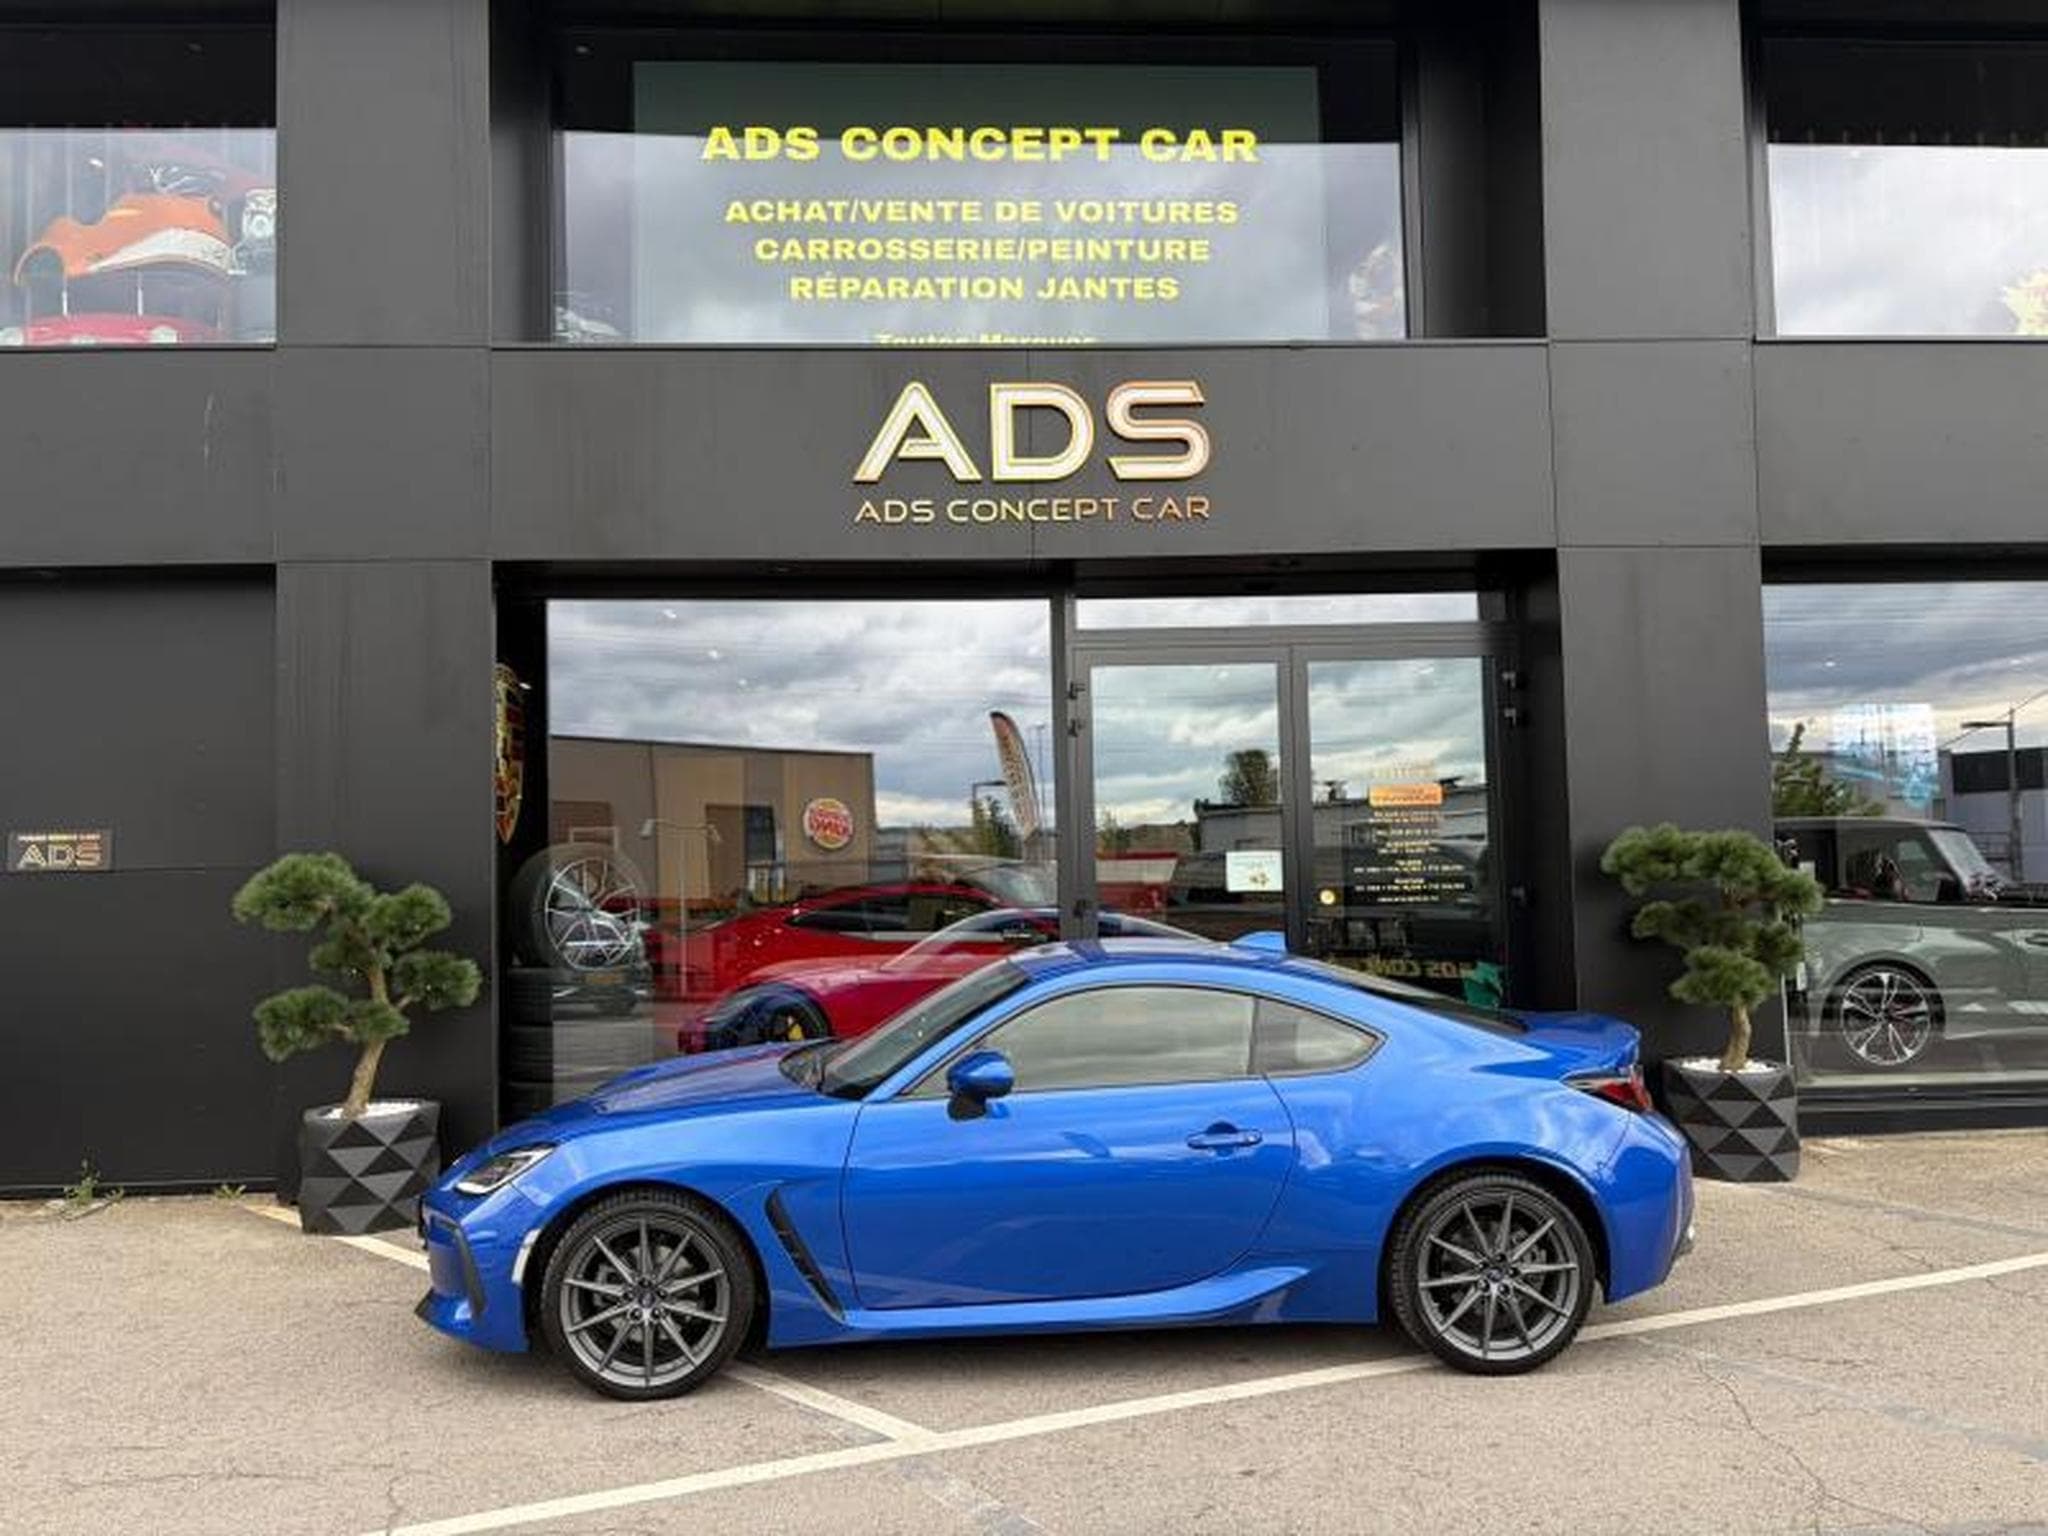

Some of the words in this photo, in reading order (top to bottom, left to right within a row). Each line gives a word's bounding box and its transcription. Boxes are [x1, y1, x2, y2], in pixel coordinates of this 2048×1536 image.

[702, 126, 820, 161] ADS
[841, 126, 1119, 162] CONCEPT
[1141, 128, 1259, 163] CAR
[725, 200, 982, 223] ACHAT/VENTE
[995, 201, 1042, 223] DE
[1055, 201, 1238, 224] VOITURES
[755, 237, 1210, 262] CARROSSERIE/PEINTURE
[791, 271, 1023, 299] RÉPARATION
[1037, 277, 1179, 300] JANTES
[852, 381, 1210, 482] ADS
[854, 500, 934, 523] ADS
[946, 499, 1118, 522] CONCEPT
[1132, 497, 1211, 519] CAR
[17, 843, 102, 868] ADS
